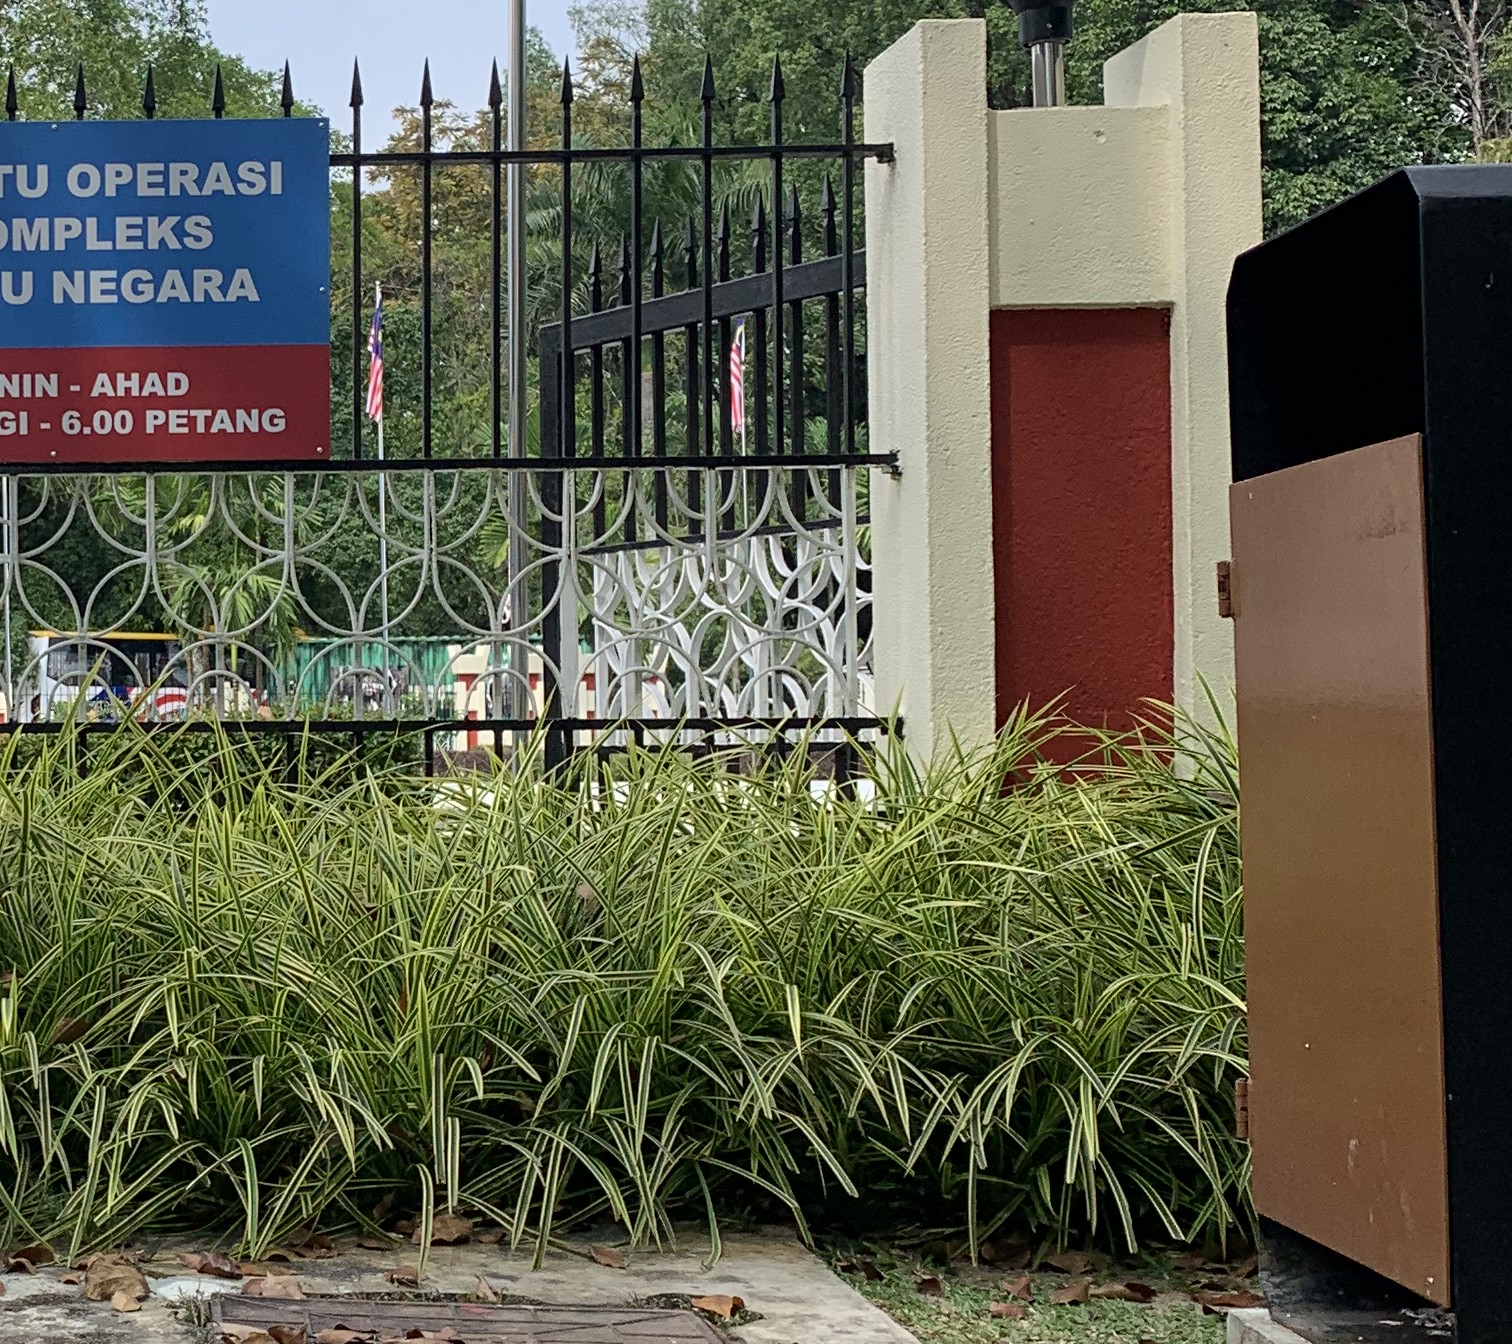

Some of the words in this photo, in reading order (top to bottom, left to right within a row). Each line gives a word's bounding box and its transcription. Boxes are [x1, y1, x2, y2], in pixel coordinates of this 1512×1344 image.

[68, 161, 282, 197] OPERASI
[53, 268, 260, 304] NEGARA
[90, 372, 190, 397] AHAD
[61, 409, 134, 435] 6.00
[145, 408, 286, 434] PETANG
